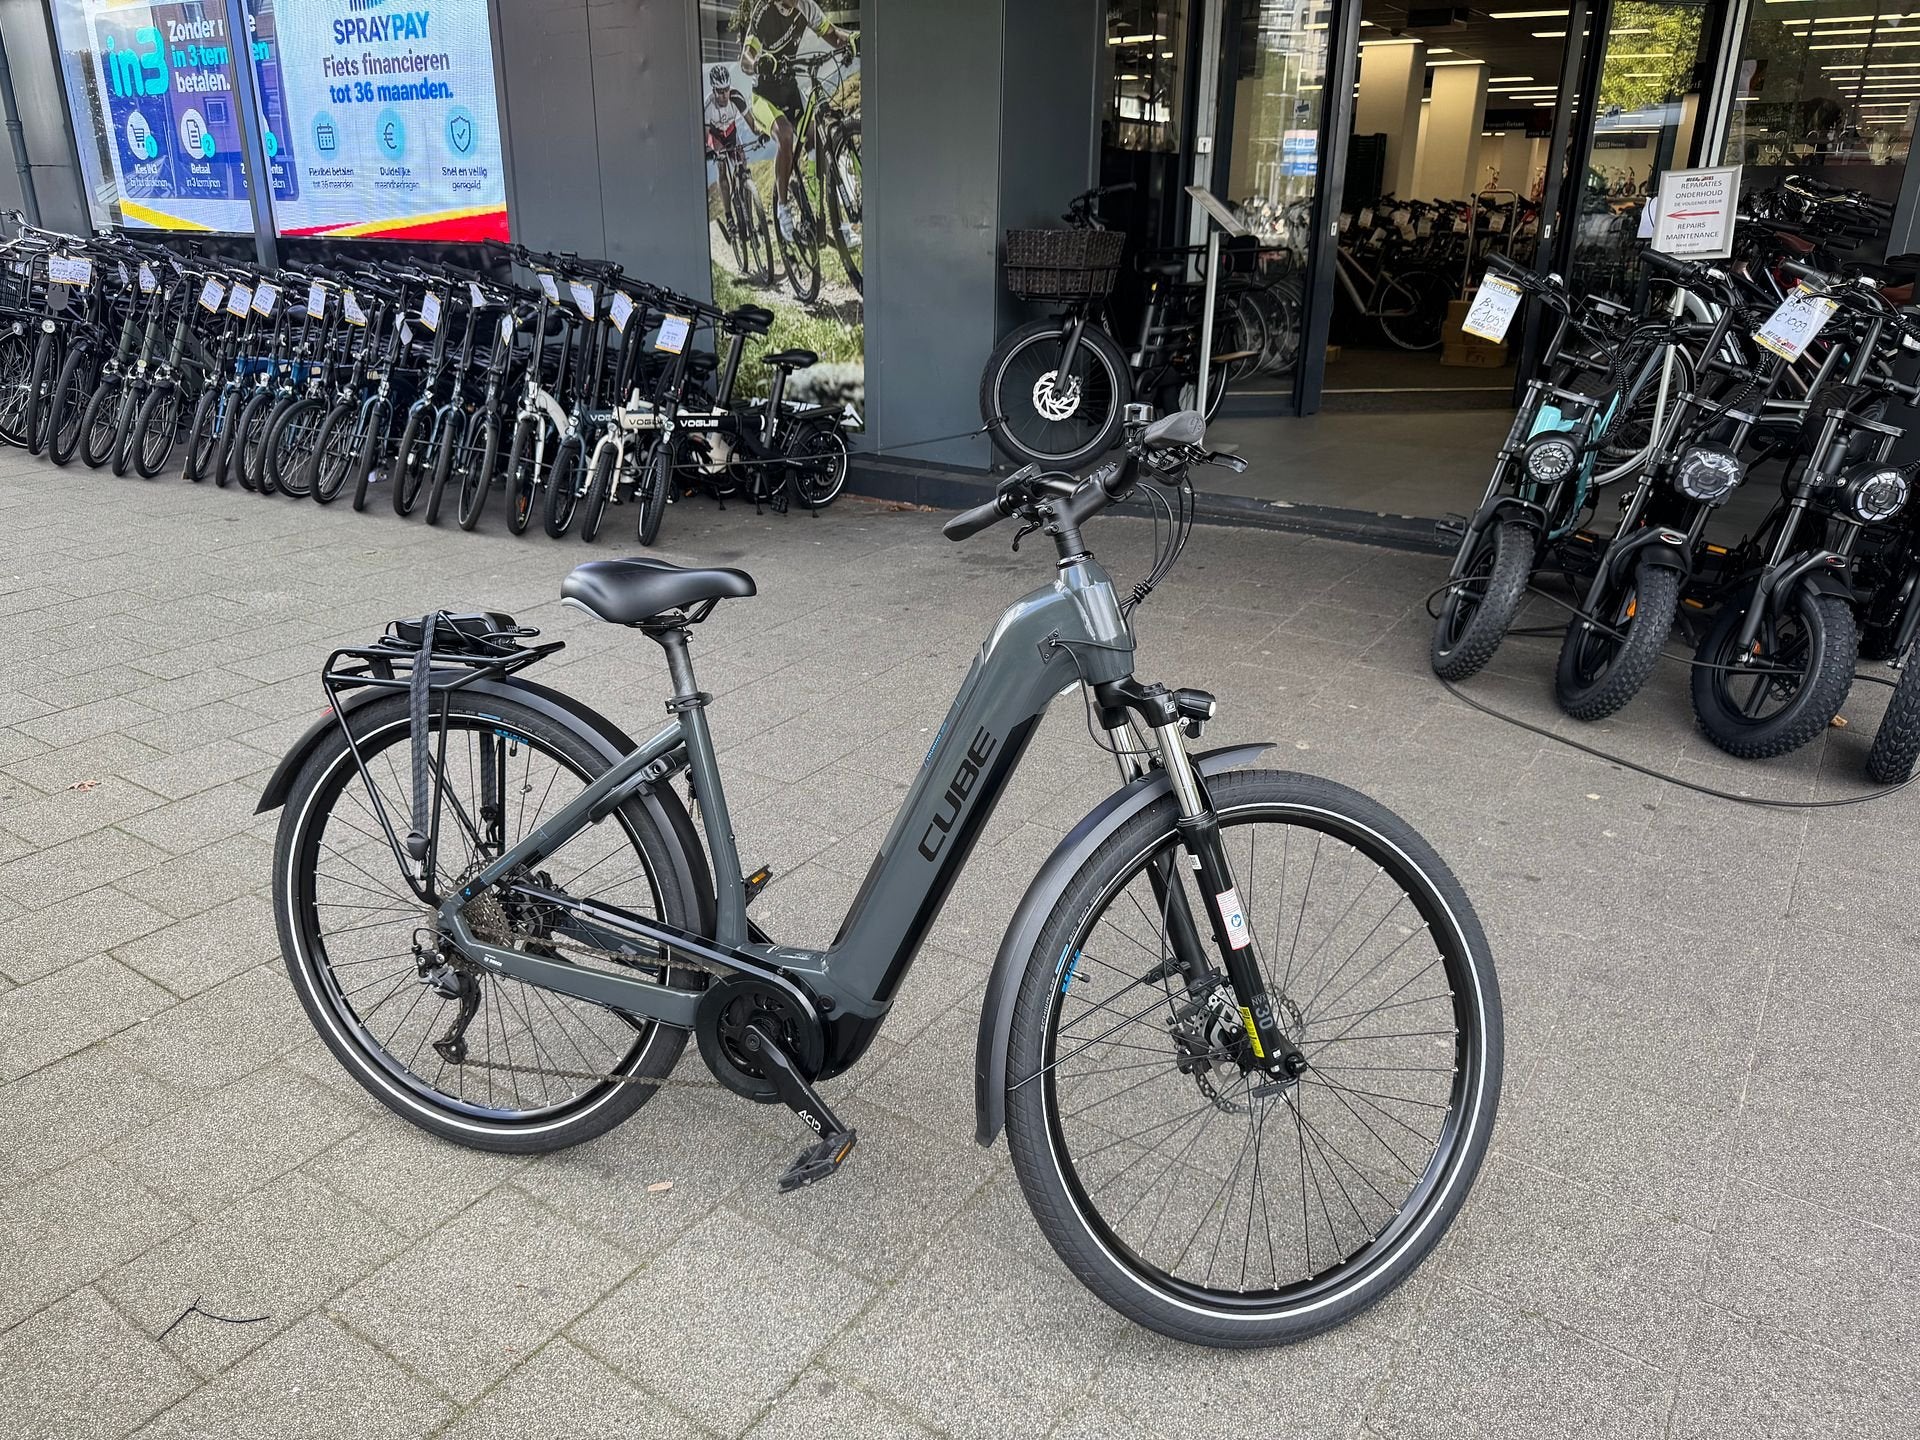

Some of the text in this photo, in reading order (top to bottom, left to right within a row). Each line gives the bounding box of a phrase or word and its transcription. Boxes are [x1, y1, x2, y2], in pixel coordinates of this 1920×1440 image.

[167, 16, 215, 42] Zonder
[333, 11, 430, 45] SPRAYPAY
[107, 25, 170, 97] in3
[171, 45, 186, 67] in
[187, 44, 198, 67] 3
[322, 48, 450, 78] Fiets financieren
[175, 70, 231, 92] betalen.
[329, 77, 454, 104] tot 36 maanden.
[441, 167, 458, 177] Snel
[459, 168, 468, 176] en
[1675, 190, 1723, 199] ONDERHOUD
[1681, 180, 1722, 189] REPARATIES
[1666, 231, 1719, 240] MAINTENANCE
[1677, 222, 1706, 230] REPAIRS
[590, 414, 612, 422] VOG
[680, 419, 719, 427] VOGUE
[918, 725, 998, 863] CUBE
[1255, 1004, 1274, 1030] 30
